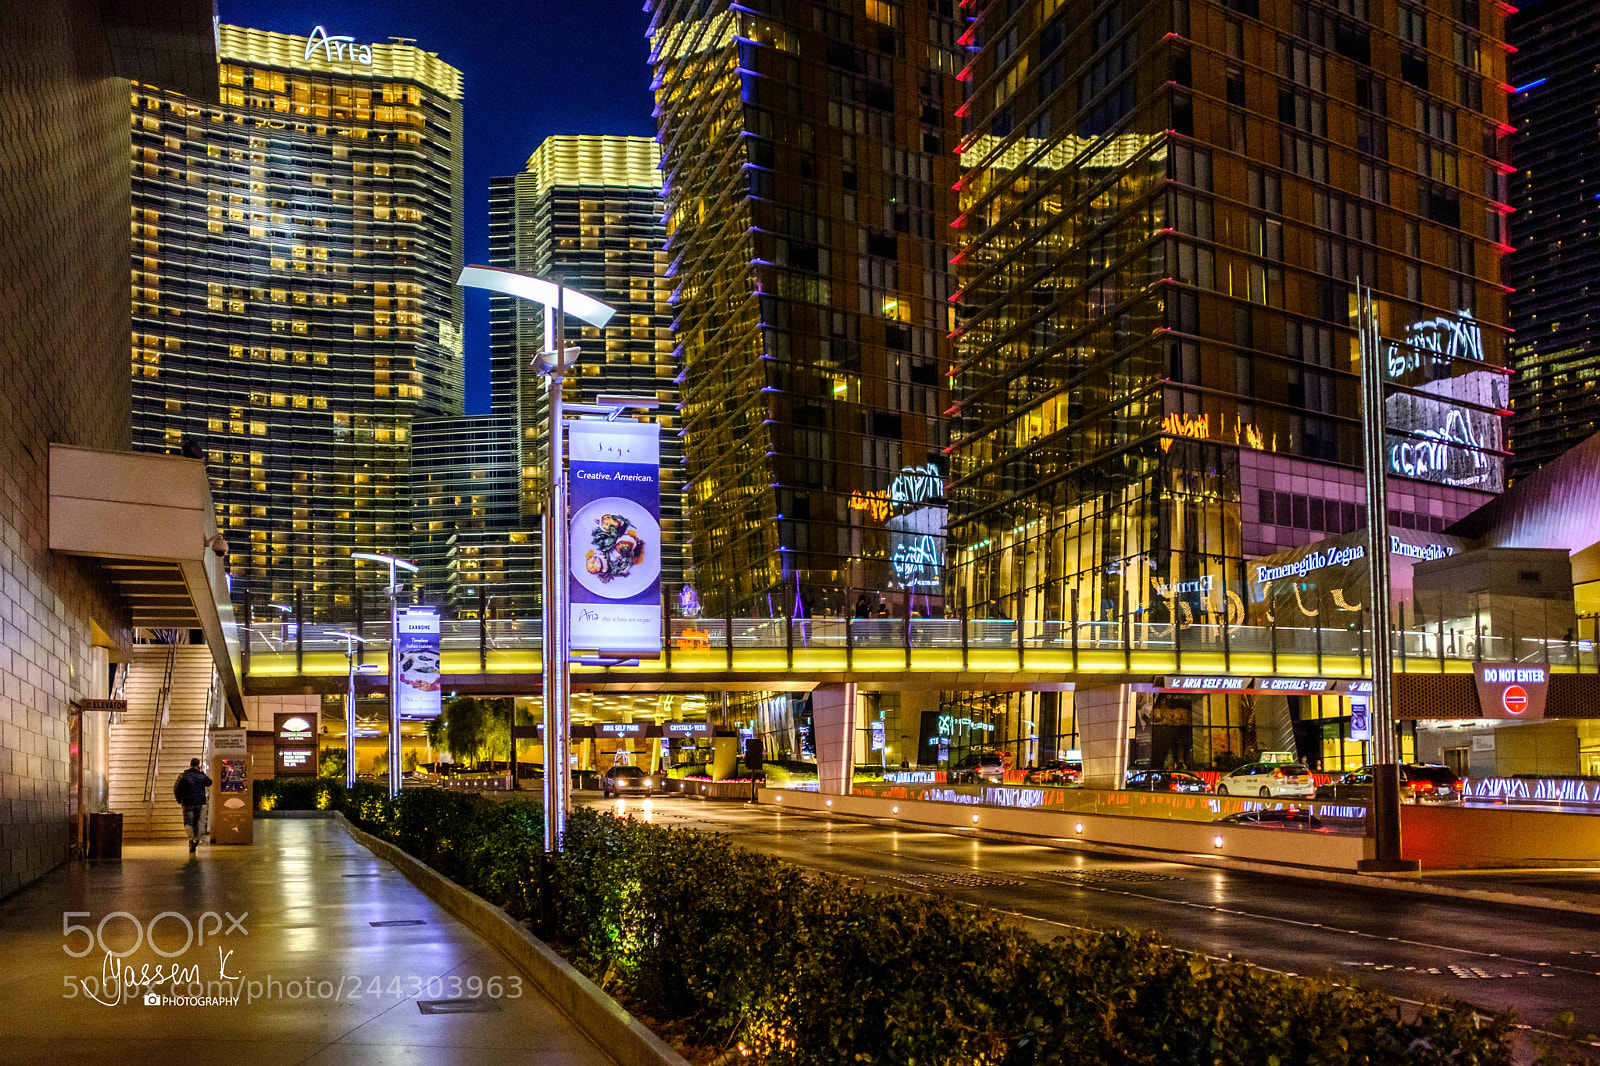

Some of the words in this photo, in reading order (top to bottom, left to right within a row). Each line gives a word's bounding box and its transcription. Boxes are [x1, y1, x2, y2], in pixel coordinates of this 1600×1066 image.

[304, 25, 373, 65] Aria
[576, 469, 612, 481] Creative.
[613, 471, 653, 482] American.
[1256, 551, 1326, 583] Ermenegildo
[1326, 545, 1365, 567] Zegna
[578, 608, 599, 622] Aria
[1484, 668, 1498, 683] DO
[1498, 668, 1517, 683] NOT
[1516, 668, 1545, 683] ENTER
[1182, 677, 1202, 689] ARIA
[1202, 678, 1222, 689] SELF
[1222, 678, 1243, 689] PARK
[93, 701, 126, 710] ELEVATOR
